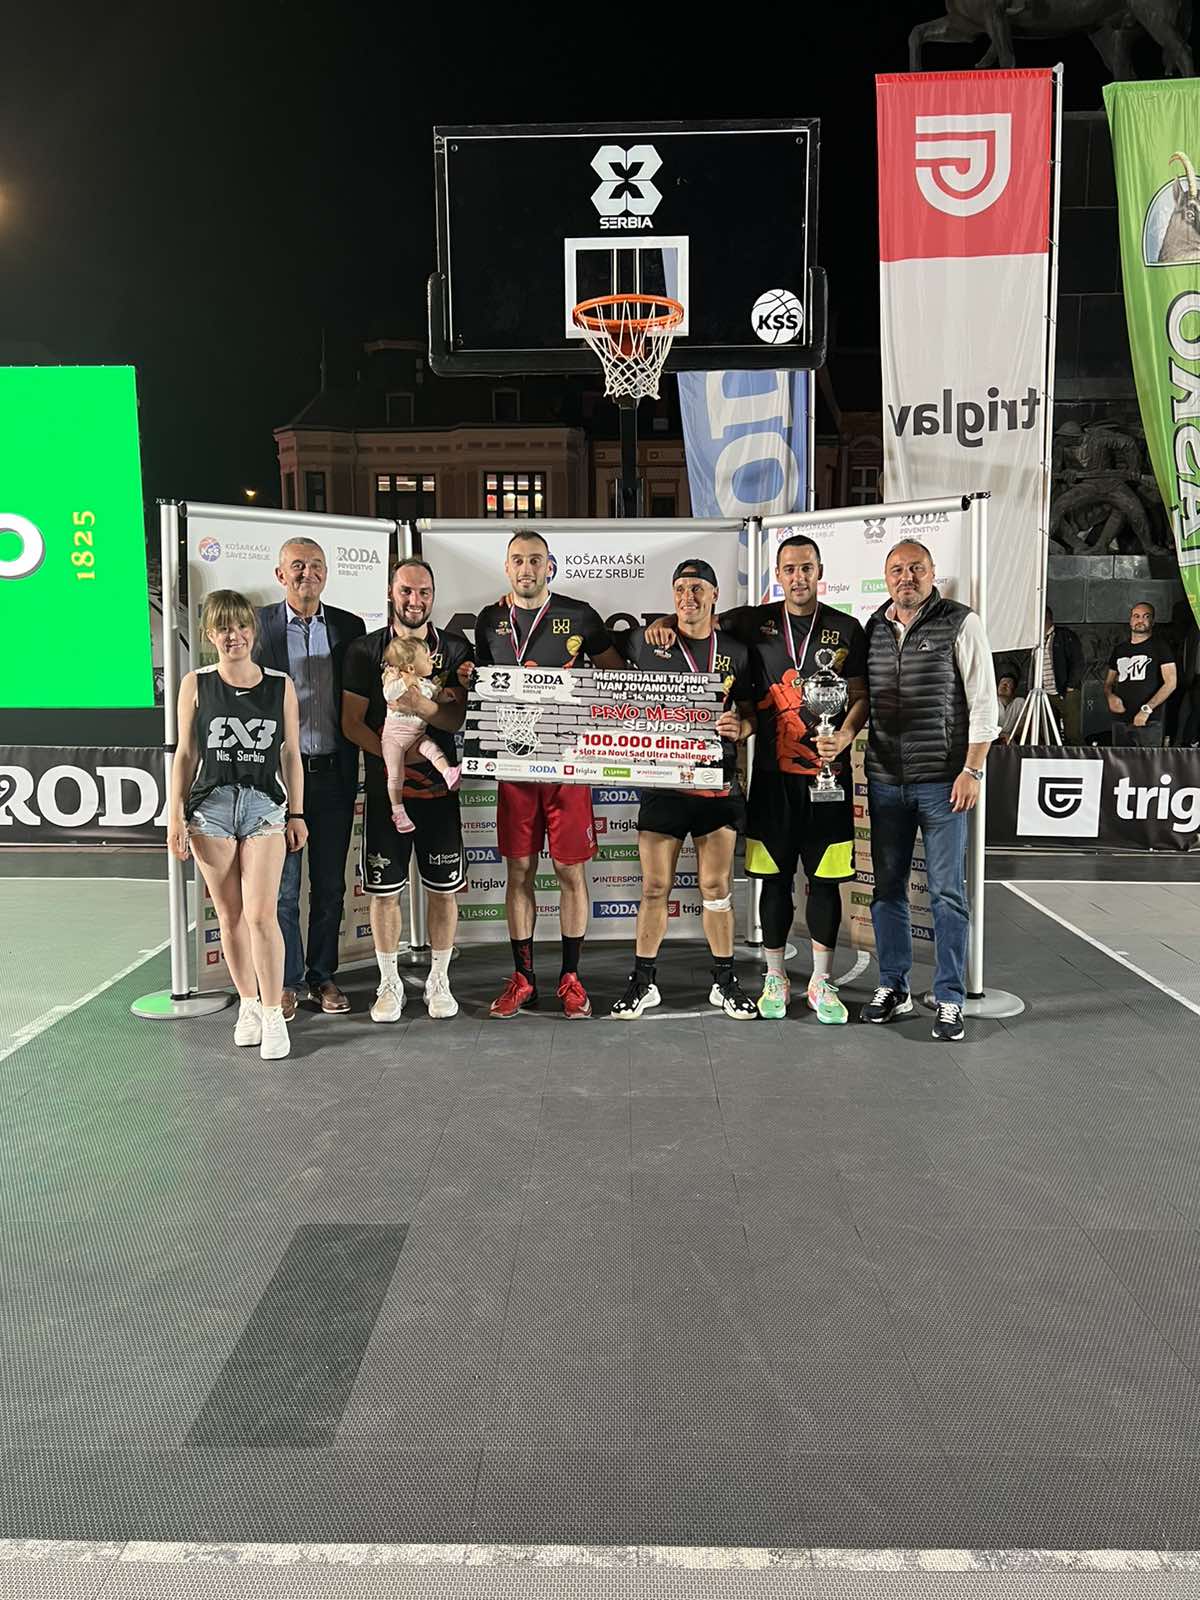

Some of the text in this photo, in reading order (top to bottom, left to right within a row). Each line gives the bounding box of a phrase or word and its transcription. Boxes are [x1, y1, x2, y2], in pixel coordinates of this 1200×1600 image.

[600, 217, 654, 229] SERBIA
[757, 313, 798, 331] KSS
[71, 510, 96, 581] 1825
[336, 546, 382, 564] RODA
[565, 552, 645, 565] KOŠARKAŠKI
[565, 568, 645, 579] SAVEZ SRBIJE
[828, 582, 850, 593] triglav
[1116, 654, 1153, 683] MTV
[523, 673, 564, 685] RODA
[592, 671, 709, 685] MEMORIJALNI TURNIR
[596, 681, 705, 694] IVAN JOVANOVIĆ ICA
[612, 691, 627, 701] NIŠ
[633, 693, 645, 701] 14.
[646, 694, 664, 702] MAJ
[665, 694, 689, 702] 2022.
[590, 703, 711, 723] PRVO MESTO
[622, 719, 691, 733] SENIORI
[582, 734, 707, 750] 100.000 dinara
[237, 750, 265, 763] Serbia
[629, 750, 646, 758] Sad
[647, 751, 668, 759] Ultra
[670, 752, 716, 762] Challenger
[528, 765, 557, 773] RODA
[575, 767, 597, 776] triglav
[0, 765, 167, 827] ROD
[599, 790, 640, 802] RODA
[1114, 774, 1200, 833] trig
[609, 818, 638, 832] trigla
[466, 849, 497, 861] ODA
[911, 859, 928, 870] OD
[373, 871, 382, 884] 3
[600, 875, 643, 883] INTERSPOR
[673, 875, 698, 886] ROD
[857, 872, 875, 883] ROD
[471, 878, 506, 891] triglav
[911, 882, 928, 894] trigl
[600, 903, 638, 915] RODA
[682, 903, 704, 916] trig
